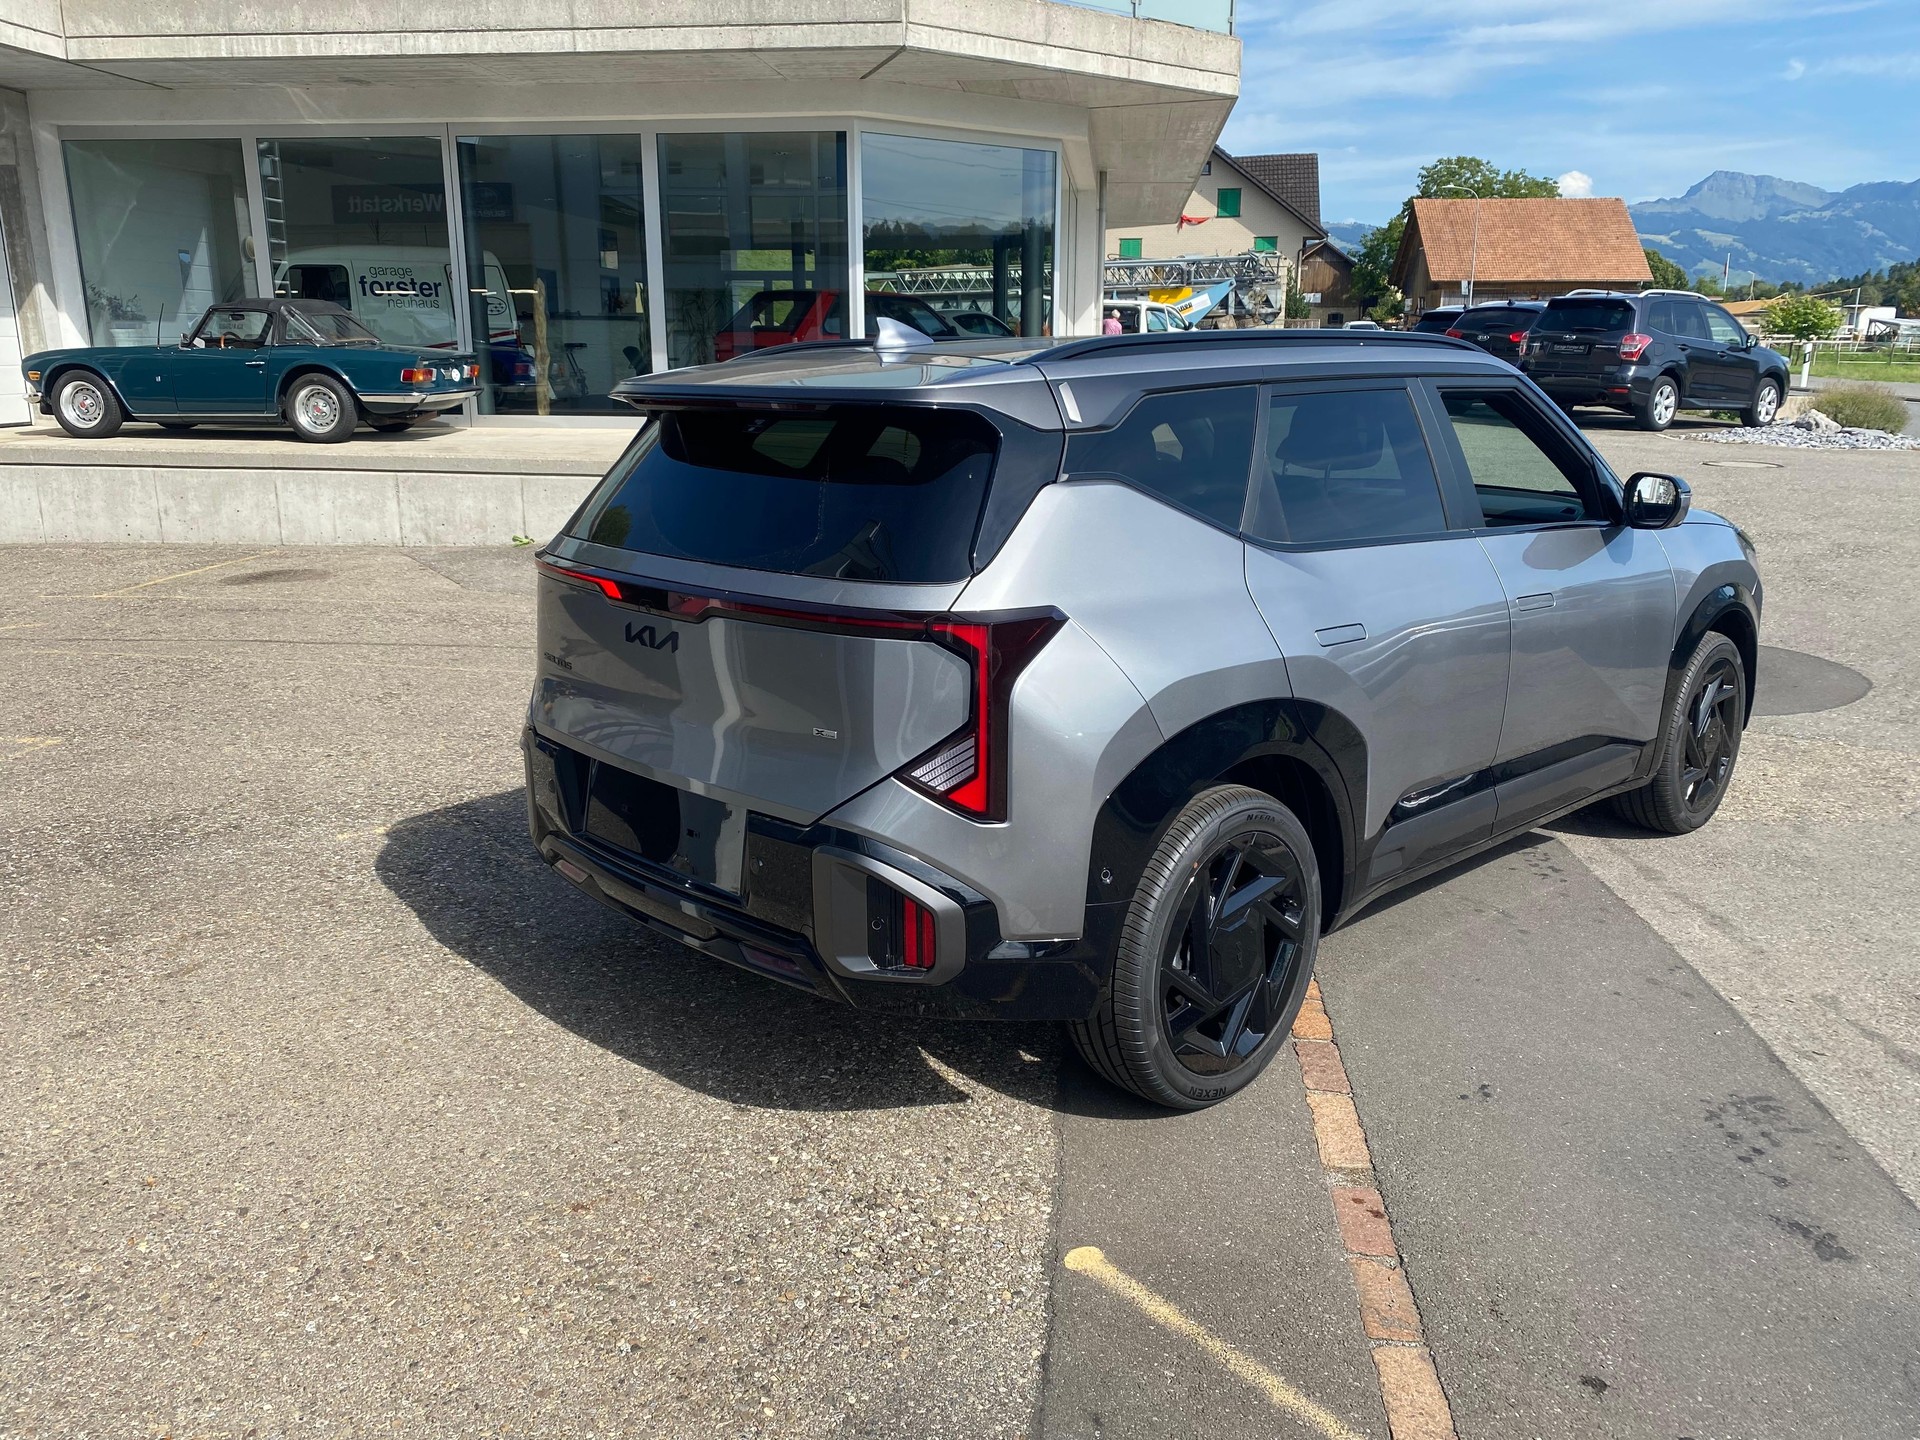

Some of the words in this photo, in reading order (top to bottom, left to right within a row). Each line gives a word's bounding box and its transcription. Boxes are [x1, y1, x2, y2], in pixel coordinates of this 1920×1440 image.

[369, 266, 413, 279] garage
[358, 275, 442, 298] forster
[387, 296, 440, 309] neuhaus
[624, 621, 680, 654] KIA
[1189, 1086, 1227, 1098] NEXEN
